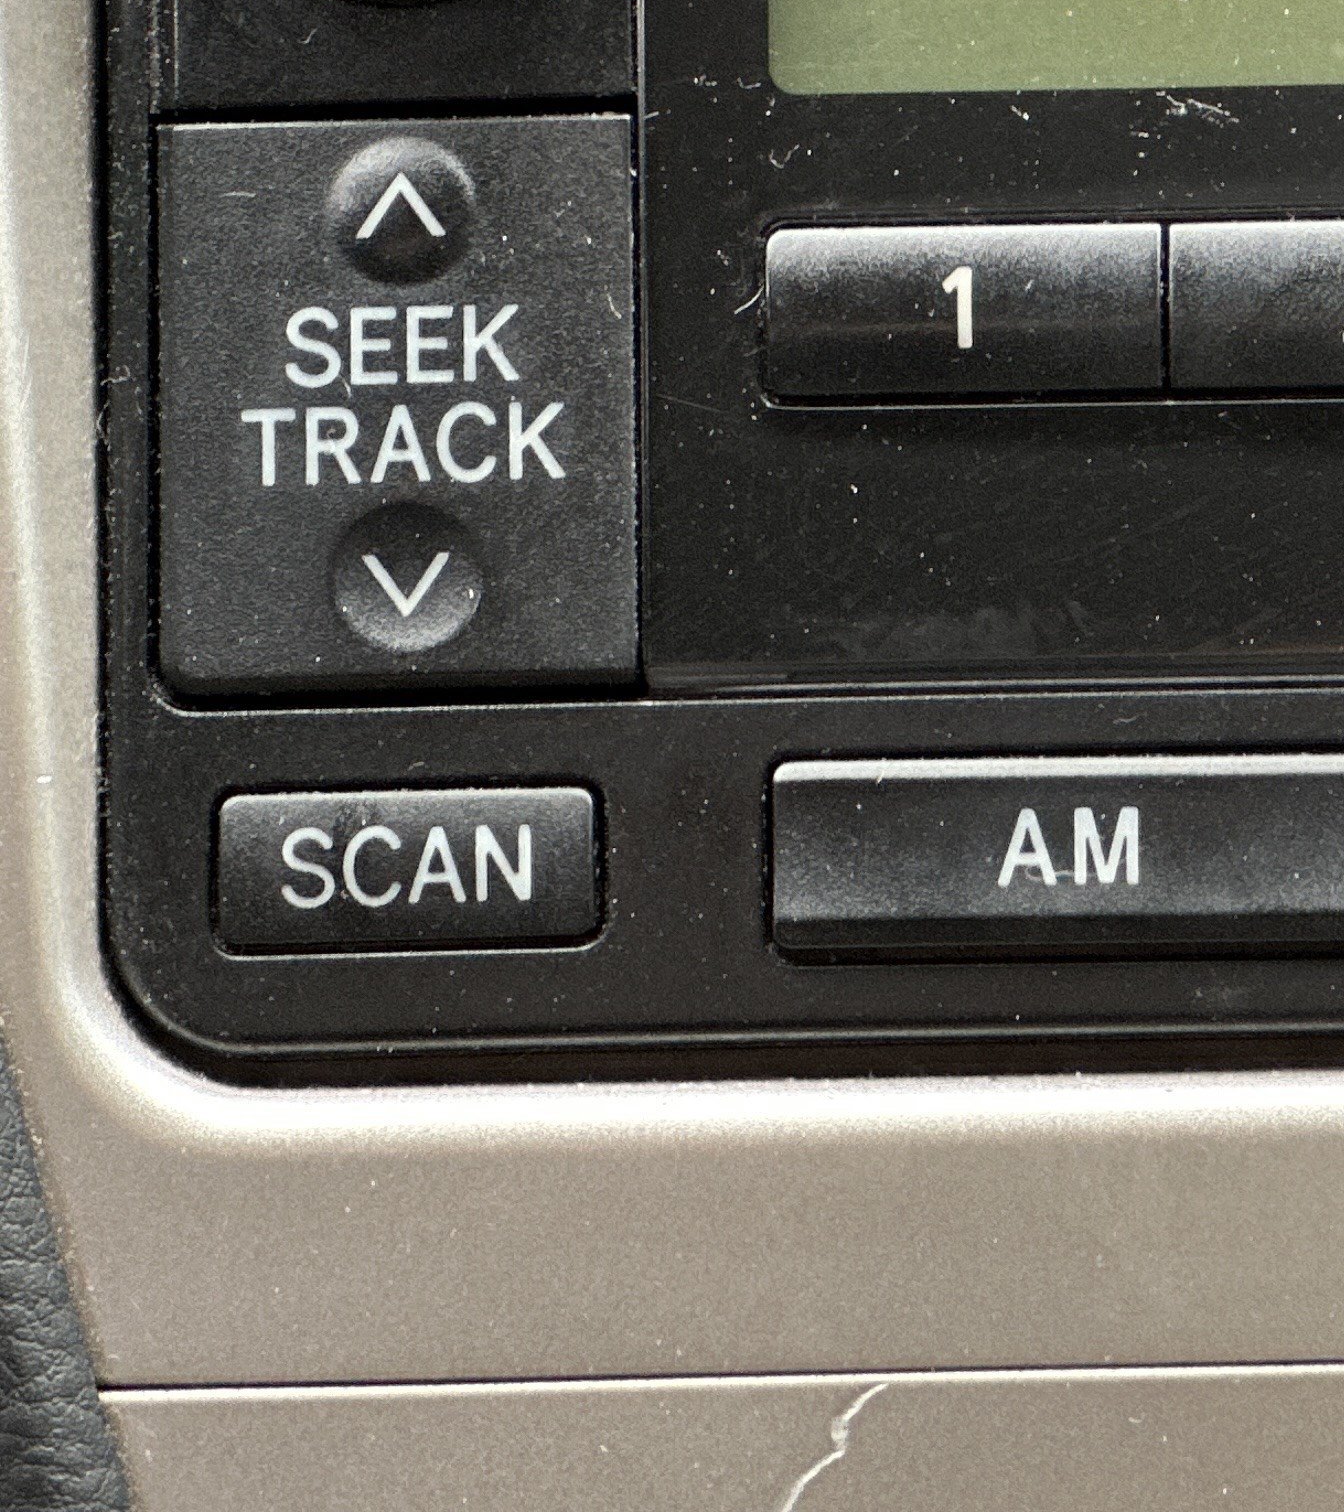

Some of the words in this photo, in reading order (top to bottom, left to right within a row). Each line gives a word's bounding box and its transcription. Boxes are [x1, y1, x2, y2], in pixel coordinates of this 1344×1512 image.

[284, 305, 519, 389] SEEK
[942, 265, 975, 349] 1
[242, 402, 566, 486] TRACK
[281, 824, 531, 909] SCAN
[997, 806, 1140, 886] AM
